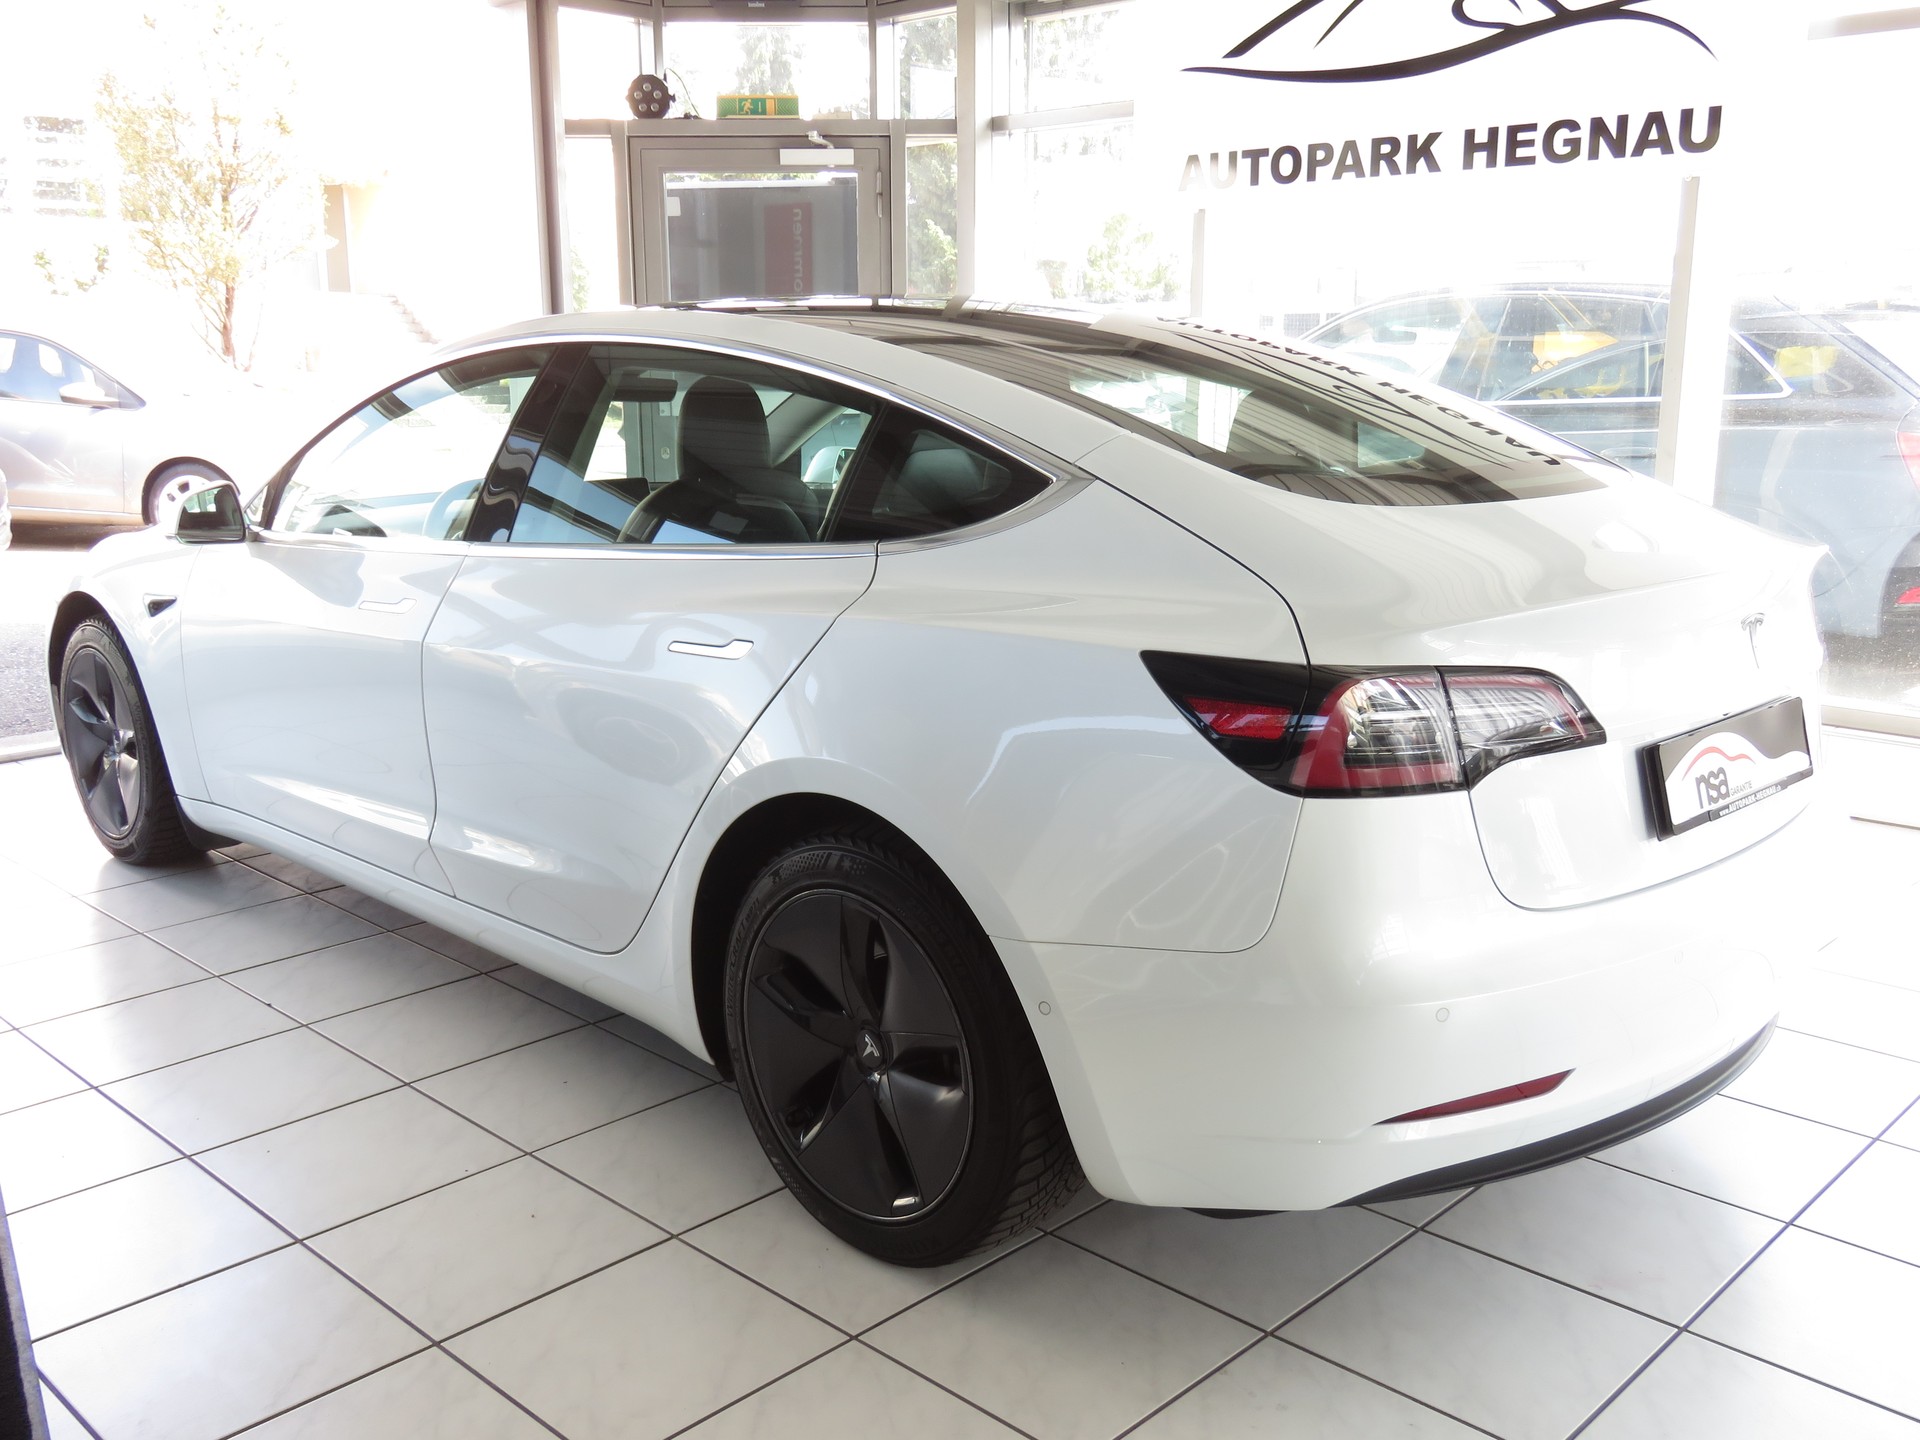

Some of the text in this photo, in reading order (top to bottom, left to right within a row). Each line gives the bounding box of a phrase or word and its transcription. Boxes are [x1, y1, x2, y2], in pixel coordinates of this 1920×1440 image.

[1178, 105, 1723, 191] AUTOPARK HEGNAU
[1695, 767, 1730, 809] nsa
[1730, 780, 1753, 797] GARANTIE
